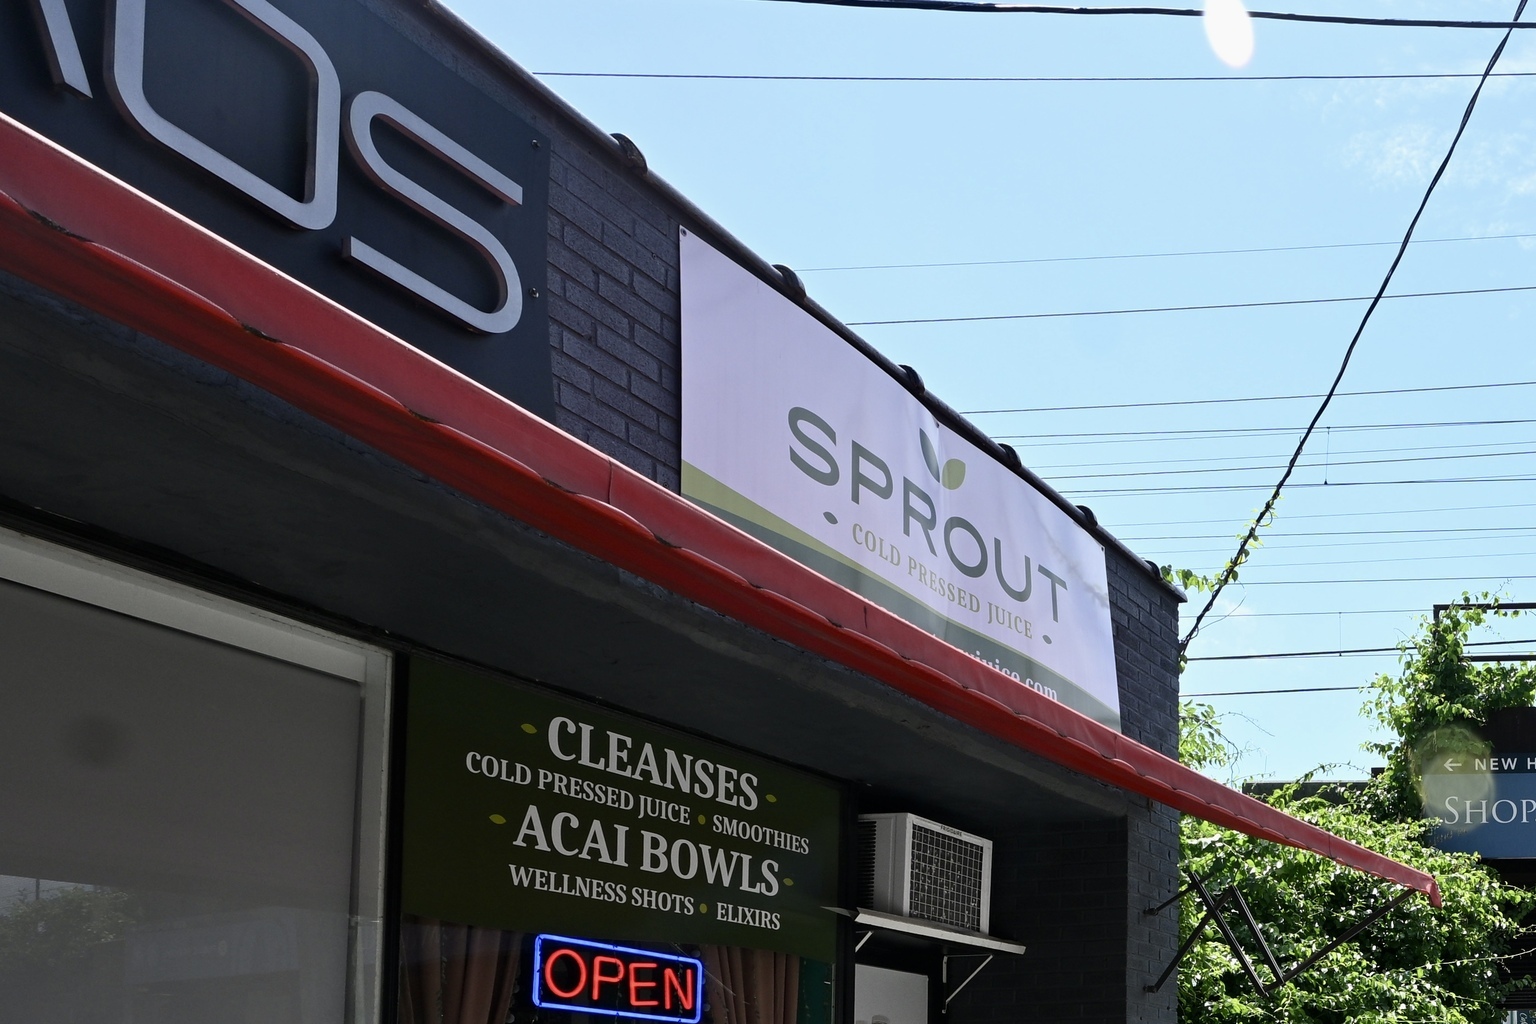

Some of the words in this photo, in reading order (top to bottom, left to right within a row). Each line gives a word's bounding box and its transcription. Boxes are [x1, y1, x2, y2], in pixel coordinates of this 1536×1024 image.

[787, 406, 1068, 623] SPROUT
[852, 523, 901, 567] COLD
[907, 556, 981, 614] PRESSED
[987, 602, 1034, 639] JUICE
[465, 751, 531, 785] COLD
[537, 768, 634, 811] PRESSED
[638, 794, 691, 826] JUICE
[548, 716, 759, 811] CLEANSES
[1475, 757, 1517, 771] NEW
[512, 804, 629, 867] ACAI
[640, 830, 780, 896] BOWLS
[713, 814, 810, 855] SMOOTHIES
[509, 864, 627, 904] WELLNESS
[631, 887, 694, 915] SHOTS
[716, 902, 781, 931] ELIXIRS
[544, 948, 693, 1010] OPEN
